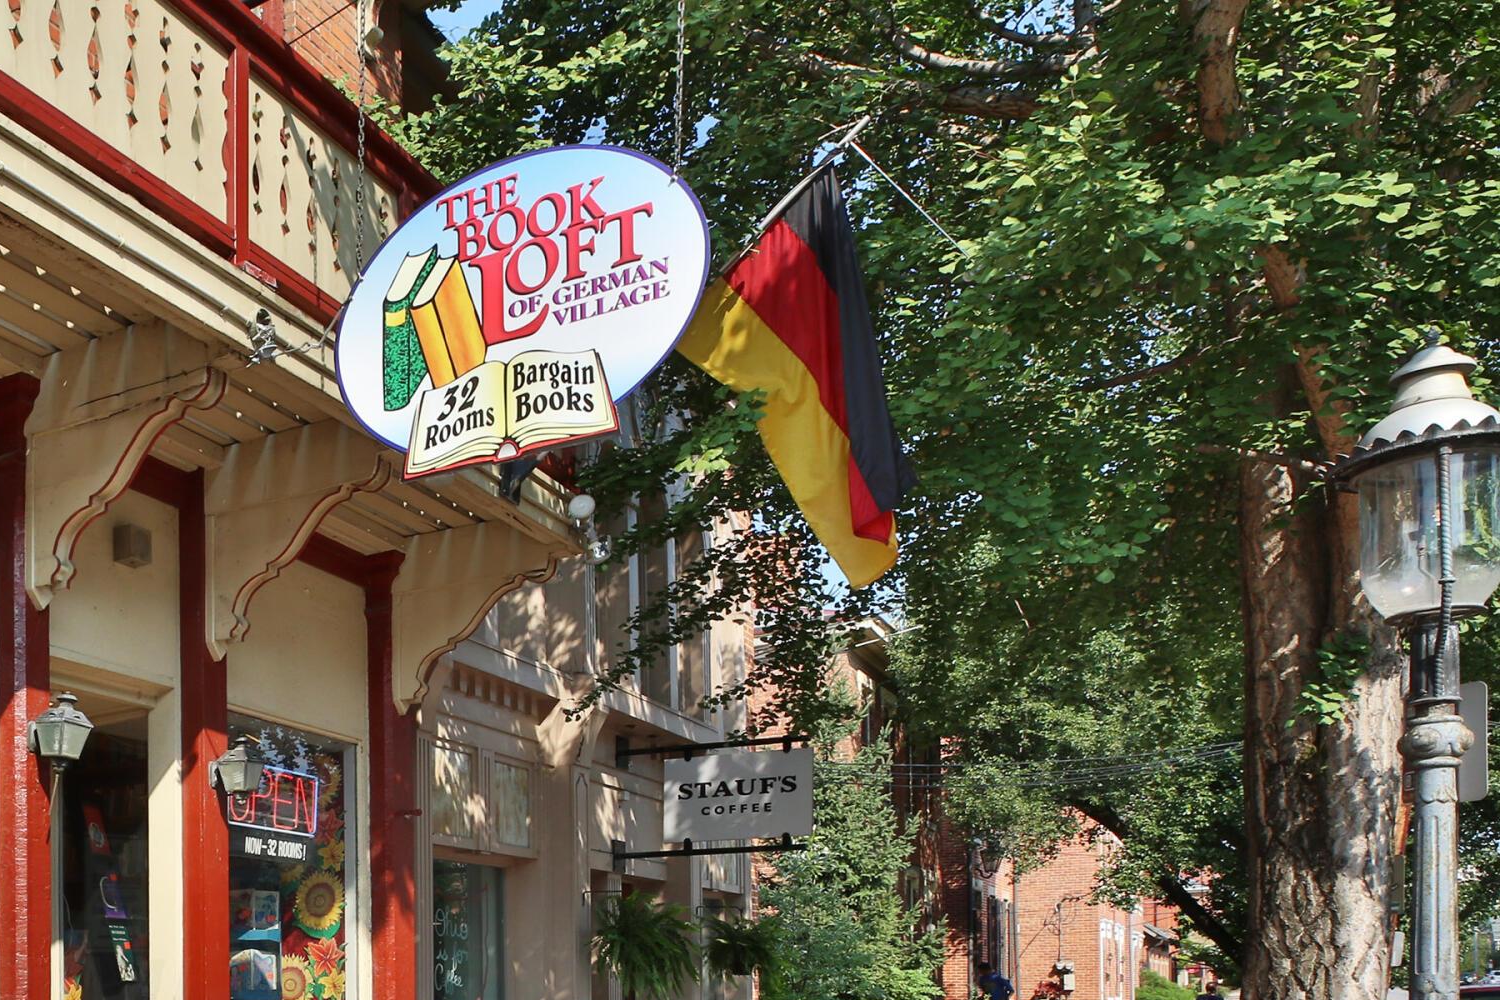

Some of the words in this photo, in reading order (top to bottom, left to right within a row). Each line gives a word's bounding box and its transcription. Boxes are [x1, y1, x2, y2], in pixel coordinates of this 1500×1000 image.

[436, 173, 520, 231] THE
[454, 176, 607, 263] BOOK
[469, 202, 653, 345] LOFT
[508, 294, 543, 318] OF
[552, 256, 670, 306] GERMAN
[552, 279, 671, 326] VILLAGE
[512, 360, 595, 393] Bargain
[437, 376, 479, 422] 32
[515, 385, 595, 423] Books
[424, 407, 496, 450] Rooms
[678, 775, 797, 800] STAUF'S
[701, 802, 772, 815] COFFEE
[435, 905, 468, 940] Ohio
